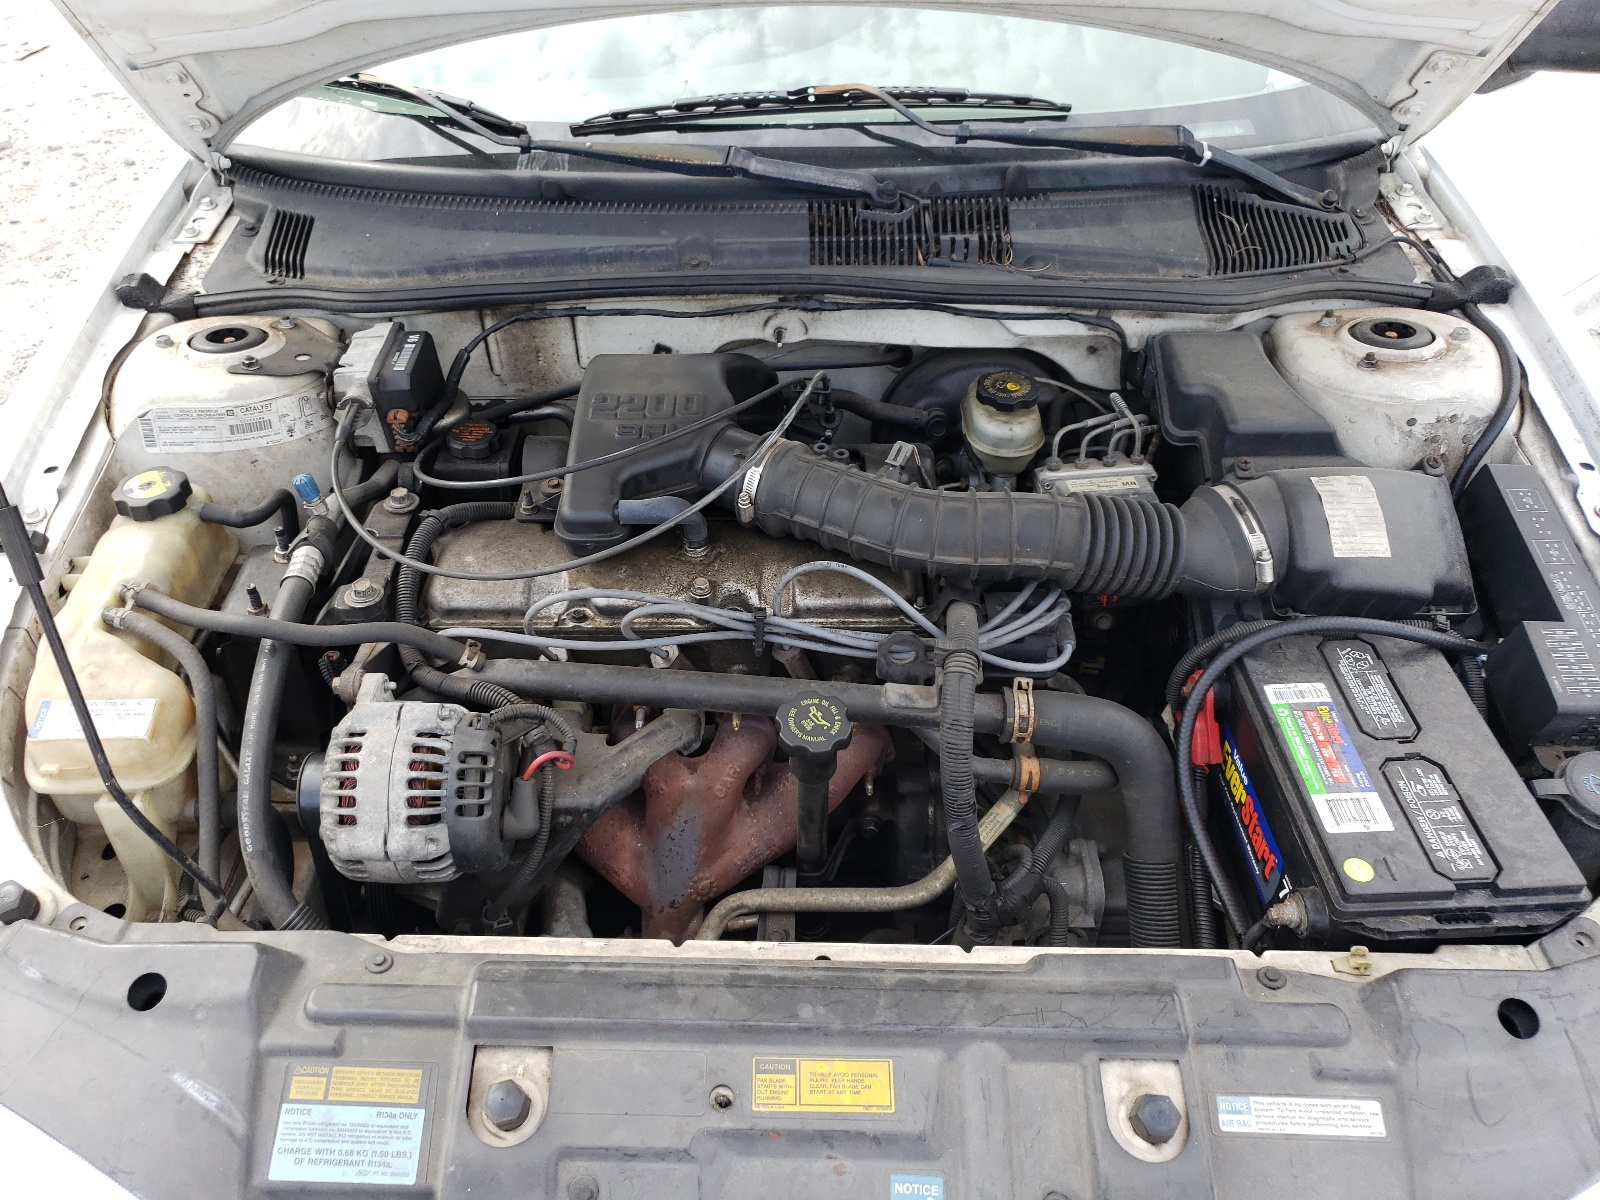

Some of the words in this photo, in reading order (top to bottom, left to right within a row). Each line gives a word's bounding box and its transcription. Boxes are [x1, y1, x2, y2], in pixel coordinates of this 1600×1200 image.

[240, 403, 272, 413] CATALYST
[589, 392, 705, 420] 2200
[800, 698, 819, 706] ENGINE
[830, 705, 839, 715] FILL
[34, 707, 48, 730] NOTICE
[788, 707, 797, 717] SEE
[802, 734, 826, 742] MANUAL
[1316, 705, 1344, 744] EverStart
[243, 750, 252, 785] GALAXY
[1234, 748, 1248, 786] Value
[1397, 780, 1418, 809] POISON
[241, 791, 252, 852] GOODYEAR
[1221, 740, 1277, 881] EverStart
[1230, 801, 1248, 843] Replacement
[1247, 843, 1260, 875] Warranty
[1417, 816, 1441, 850] DANGER
[301, 1065, 329, 1074] CAUTION
[284, 1108, 312, 1116] NOTICE
[376, 1111, 397, 1119] R134a
[399, 1112, 418, 1120] ONLY
[1220, 1101, 1249, 1111] NOTICE
[1221, 1119, 1234, 1128] AIR
[1237, 1120, 1252, 1128] BAG
[277, 1147, 312, 1156] CHARGE
[315, 1148, 335, 1156] WITH
[356, 1150, 368, 1158] KG
[370, 1150, 389, 1159] (1.50
[391, 1151, 412, 1160] LBS.)
[308, 1158, 365, 1168] REFRIGERANT
[368, 1160, 393, 1168] R134a.
[894, 1182, 939, 1197] NOTICE
